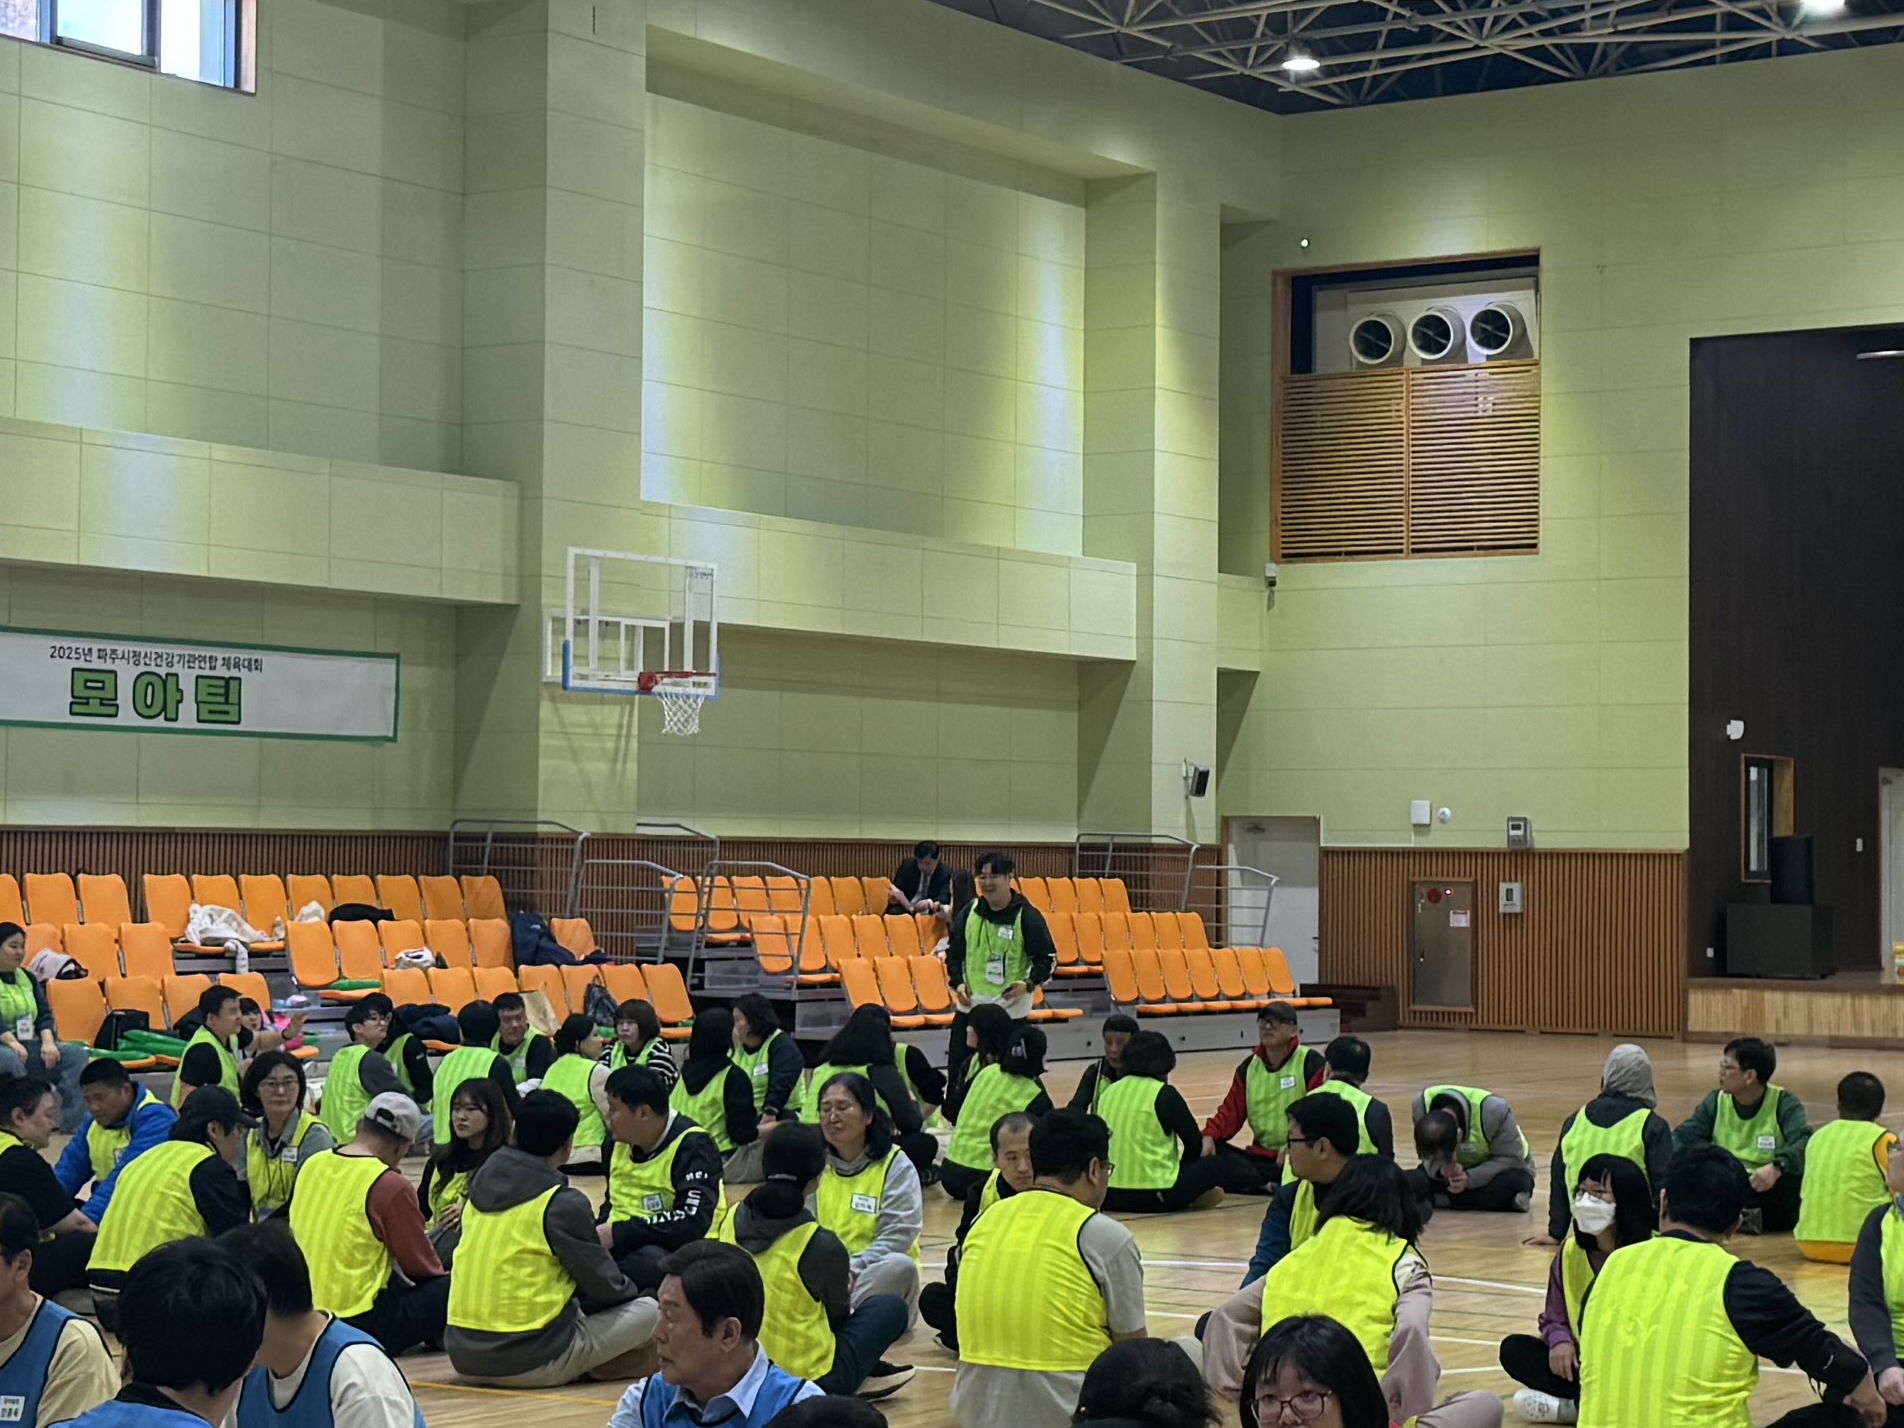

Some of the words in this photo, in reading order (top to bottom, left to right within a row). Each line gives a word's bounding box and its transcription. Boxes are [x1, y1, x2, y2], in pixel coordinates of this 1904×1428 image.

[49, 644, 94, 663] 2025년
[96, 647, 218, 671] 파주시정신건강기관연합
[221, 655, 264, 673] 체육대회
[69, 667, 243, 725] 모아팀
